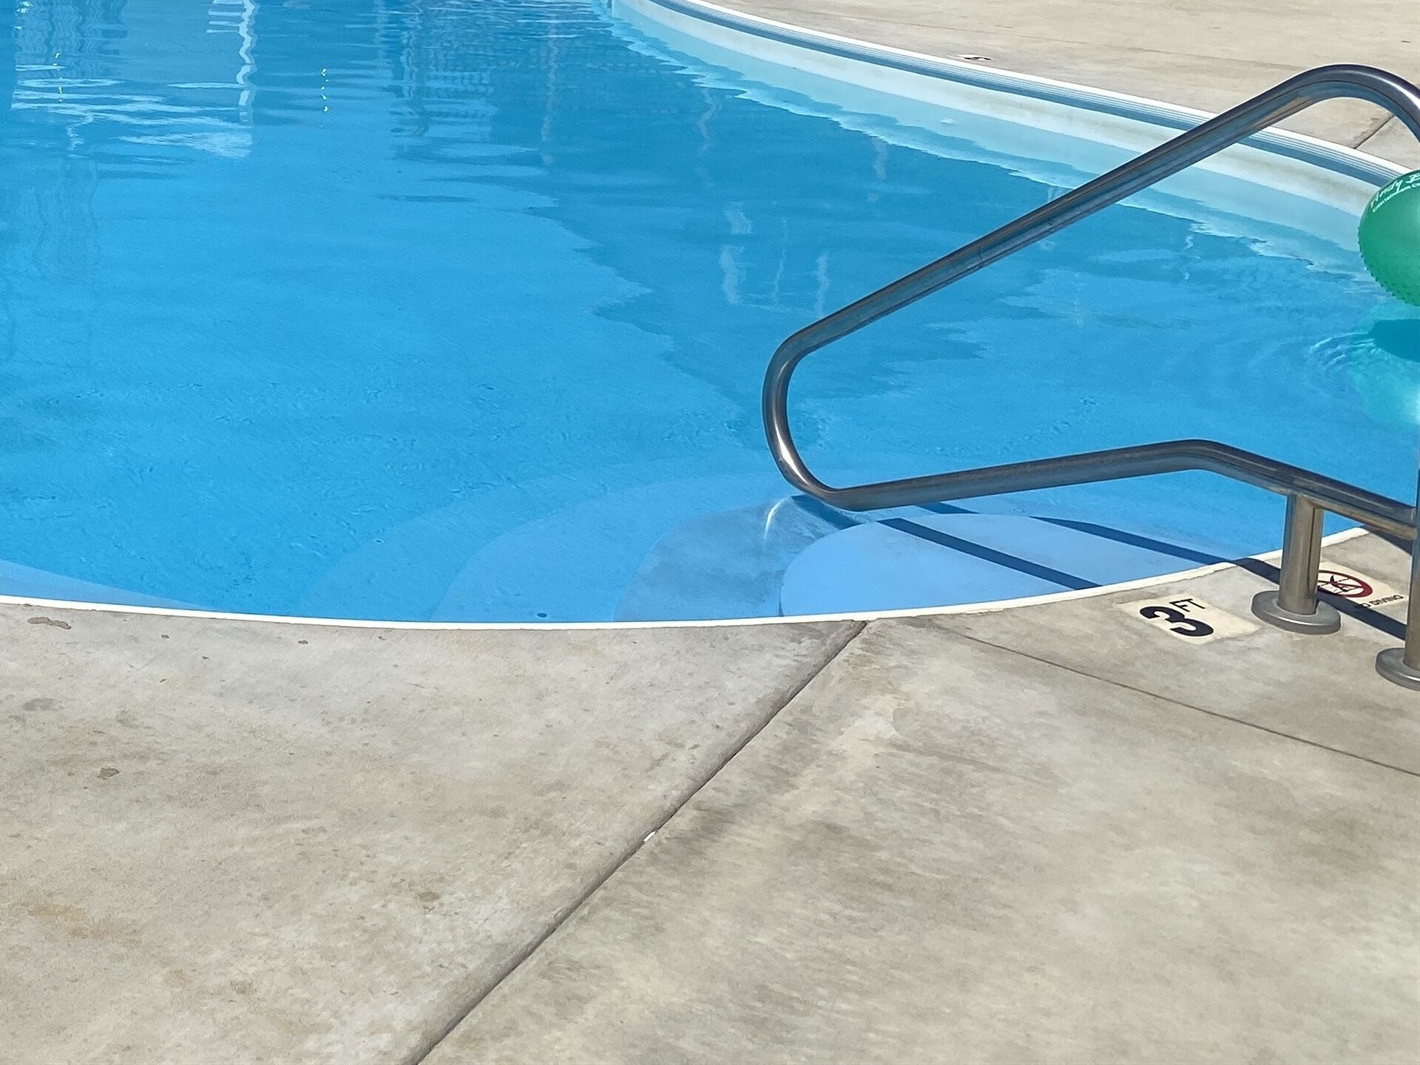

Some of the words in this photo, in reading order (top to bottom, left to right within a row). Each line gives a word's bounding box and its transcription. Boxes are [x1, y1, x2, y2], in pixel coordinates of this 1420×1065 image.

[1169, 598, 1206, 613] FT
[1369, 594, 1404, 605] DIVING
[1140, 606, 1214, 637] 3
